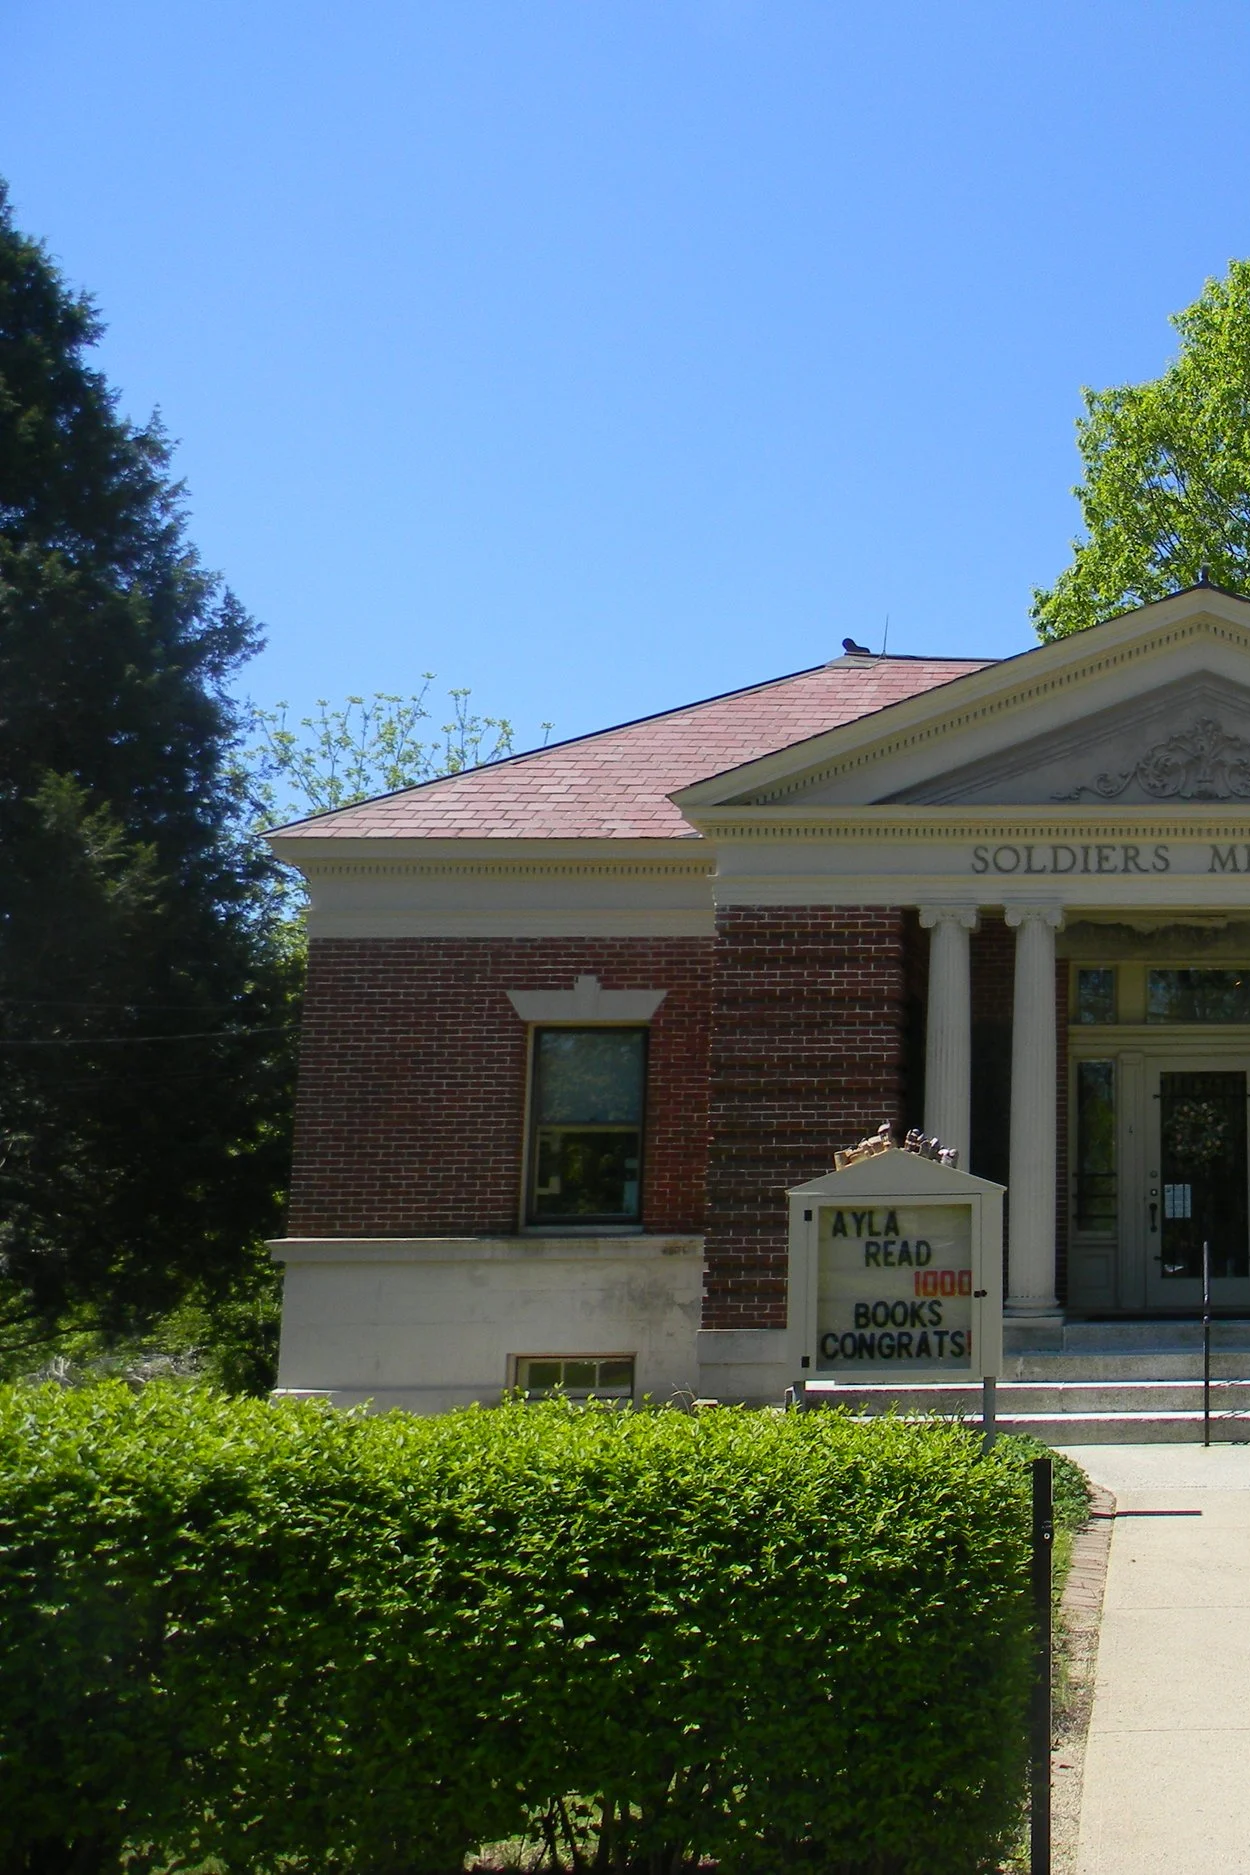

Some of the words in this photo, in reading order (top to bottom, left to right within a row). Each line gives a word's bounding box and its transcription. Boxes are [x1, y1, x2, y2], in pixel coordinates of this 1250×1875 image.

[971, 846, 1171, 875] SOLDIERS
[832, 1209, 900, 1238] AYLA
[864, 1239, 932, 1267] READ
[914, 1270, 972, 1297] 1000
[854, 1300, 943, 1330] BOOKS
